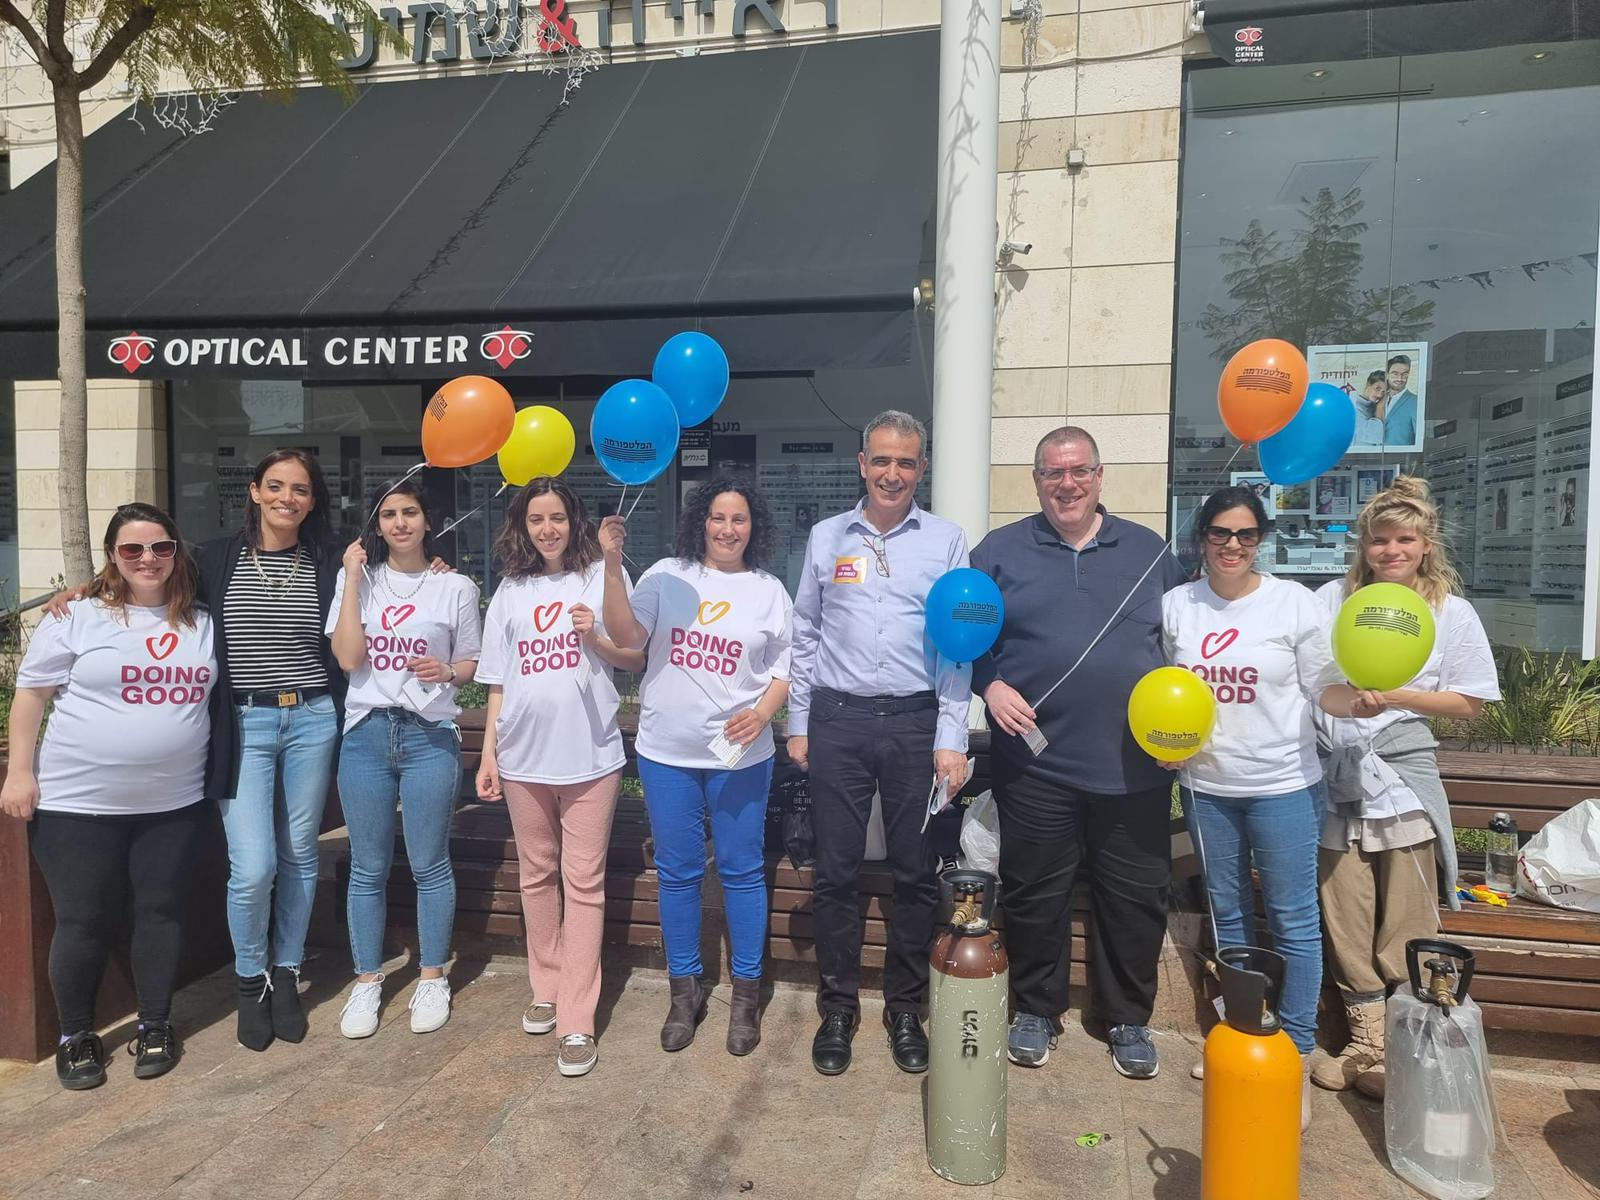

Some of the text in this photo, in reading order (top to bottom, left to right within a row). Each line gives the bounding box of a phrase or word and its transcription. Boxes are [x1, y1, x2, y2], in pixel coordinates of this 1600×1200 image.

[163, 337, 308, 367] OPTICAL
[323, 335, 469, 365] CENTER
[1242, 368, 1292, 380] הפלטפורמה
[603, 437, 653, 449] הפלטפורמה
[958, 601, 998, 611] הפלטפורמה
[518, 630, 580, 658] DOING
[671, 627, 743, 659] DOING
[521, 650, 581, 676] GOOD
[670, 647, 737, 676] GOOD
[120, 665, 211, 684] DOING
[1177, 663, 1259, 685] OING
[121, 685, 206, 705] GOOD
[1151, 729, 1198, 739] הפלטפורמה
